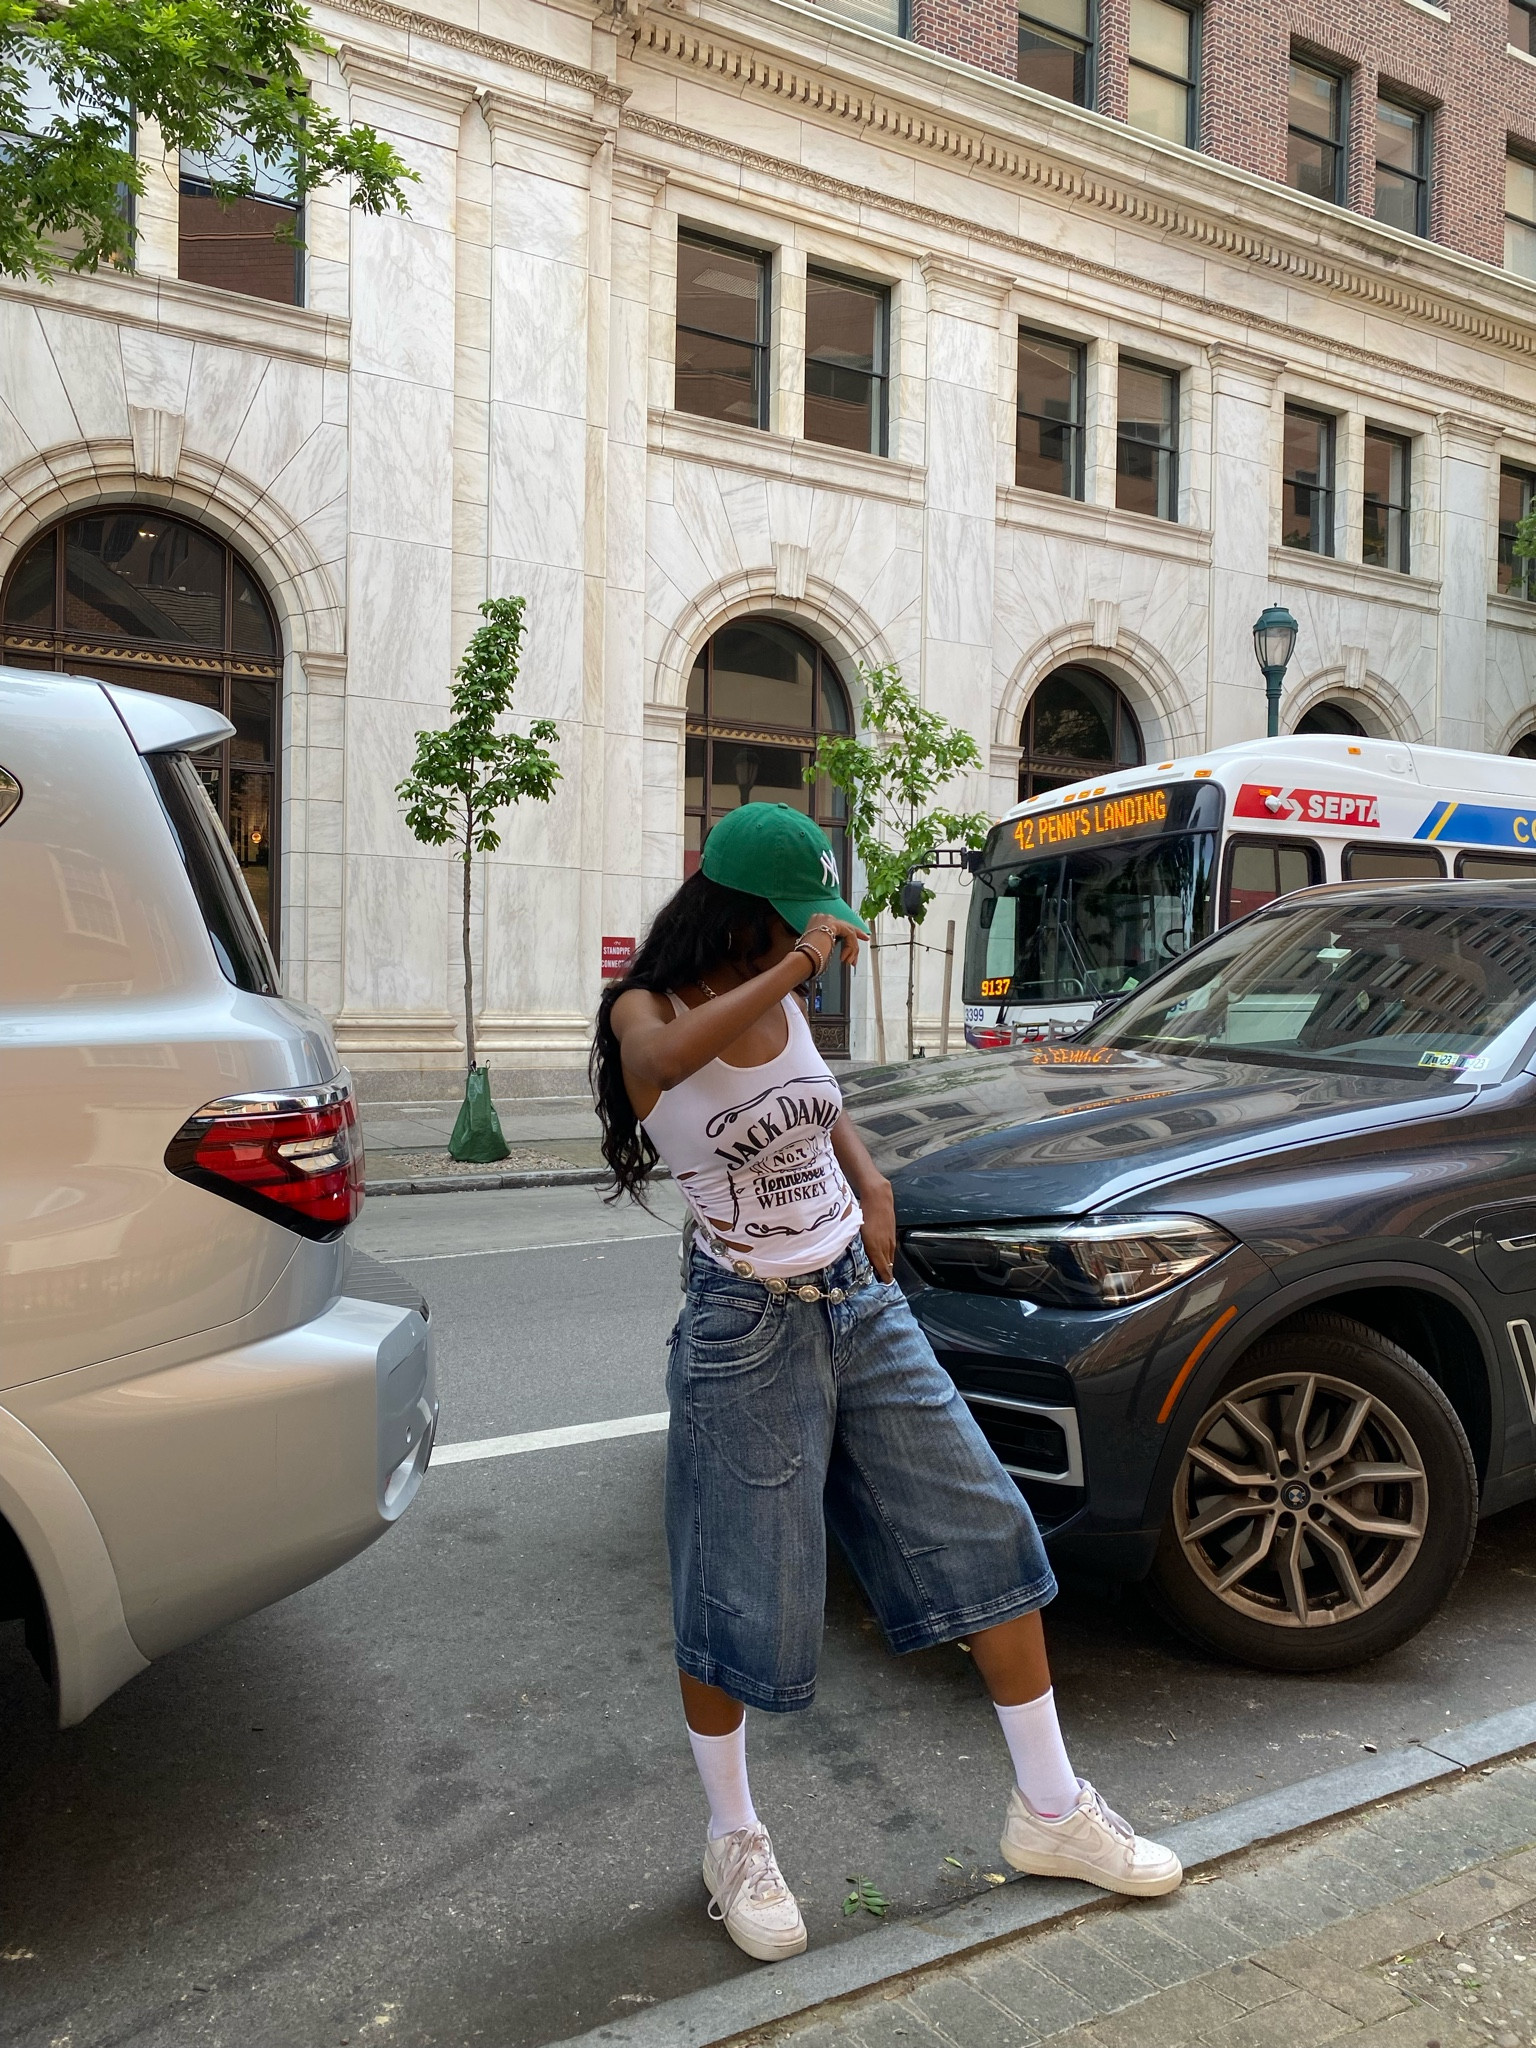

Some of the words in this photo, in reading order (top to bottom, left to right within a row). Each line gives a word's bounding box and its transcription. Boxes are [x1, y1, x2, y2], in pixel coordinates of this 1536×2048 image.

[1013, 819, 1035, 850] 42
[1038, 808, 1091, 845] PENN'S
[1094, 789, 1168, 833] LANDING
[1308, 794, 1380, 824] SEPTA
[601, 959, 632, 968] CONNECT
[603, 946, 631, 955] STANDPIPE
[981, 978, 1011, 997] 9137
[714, 1112, 783, 1171] JACK
[753, 1166, 826, 1196] Tennessee
[756, 1181, 828, 1210] WHISKEY
